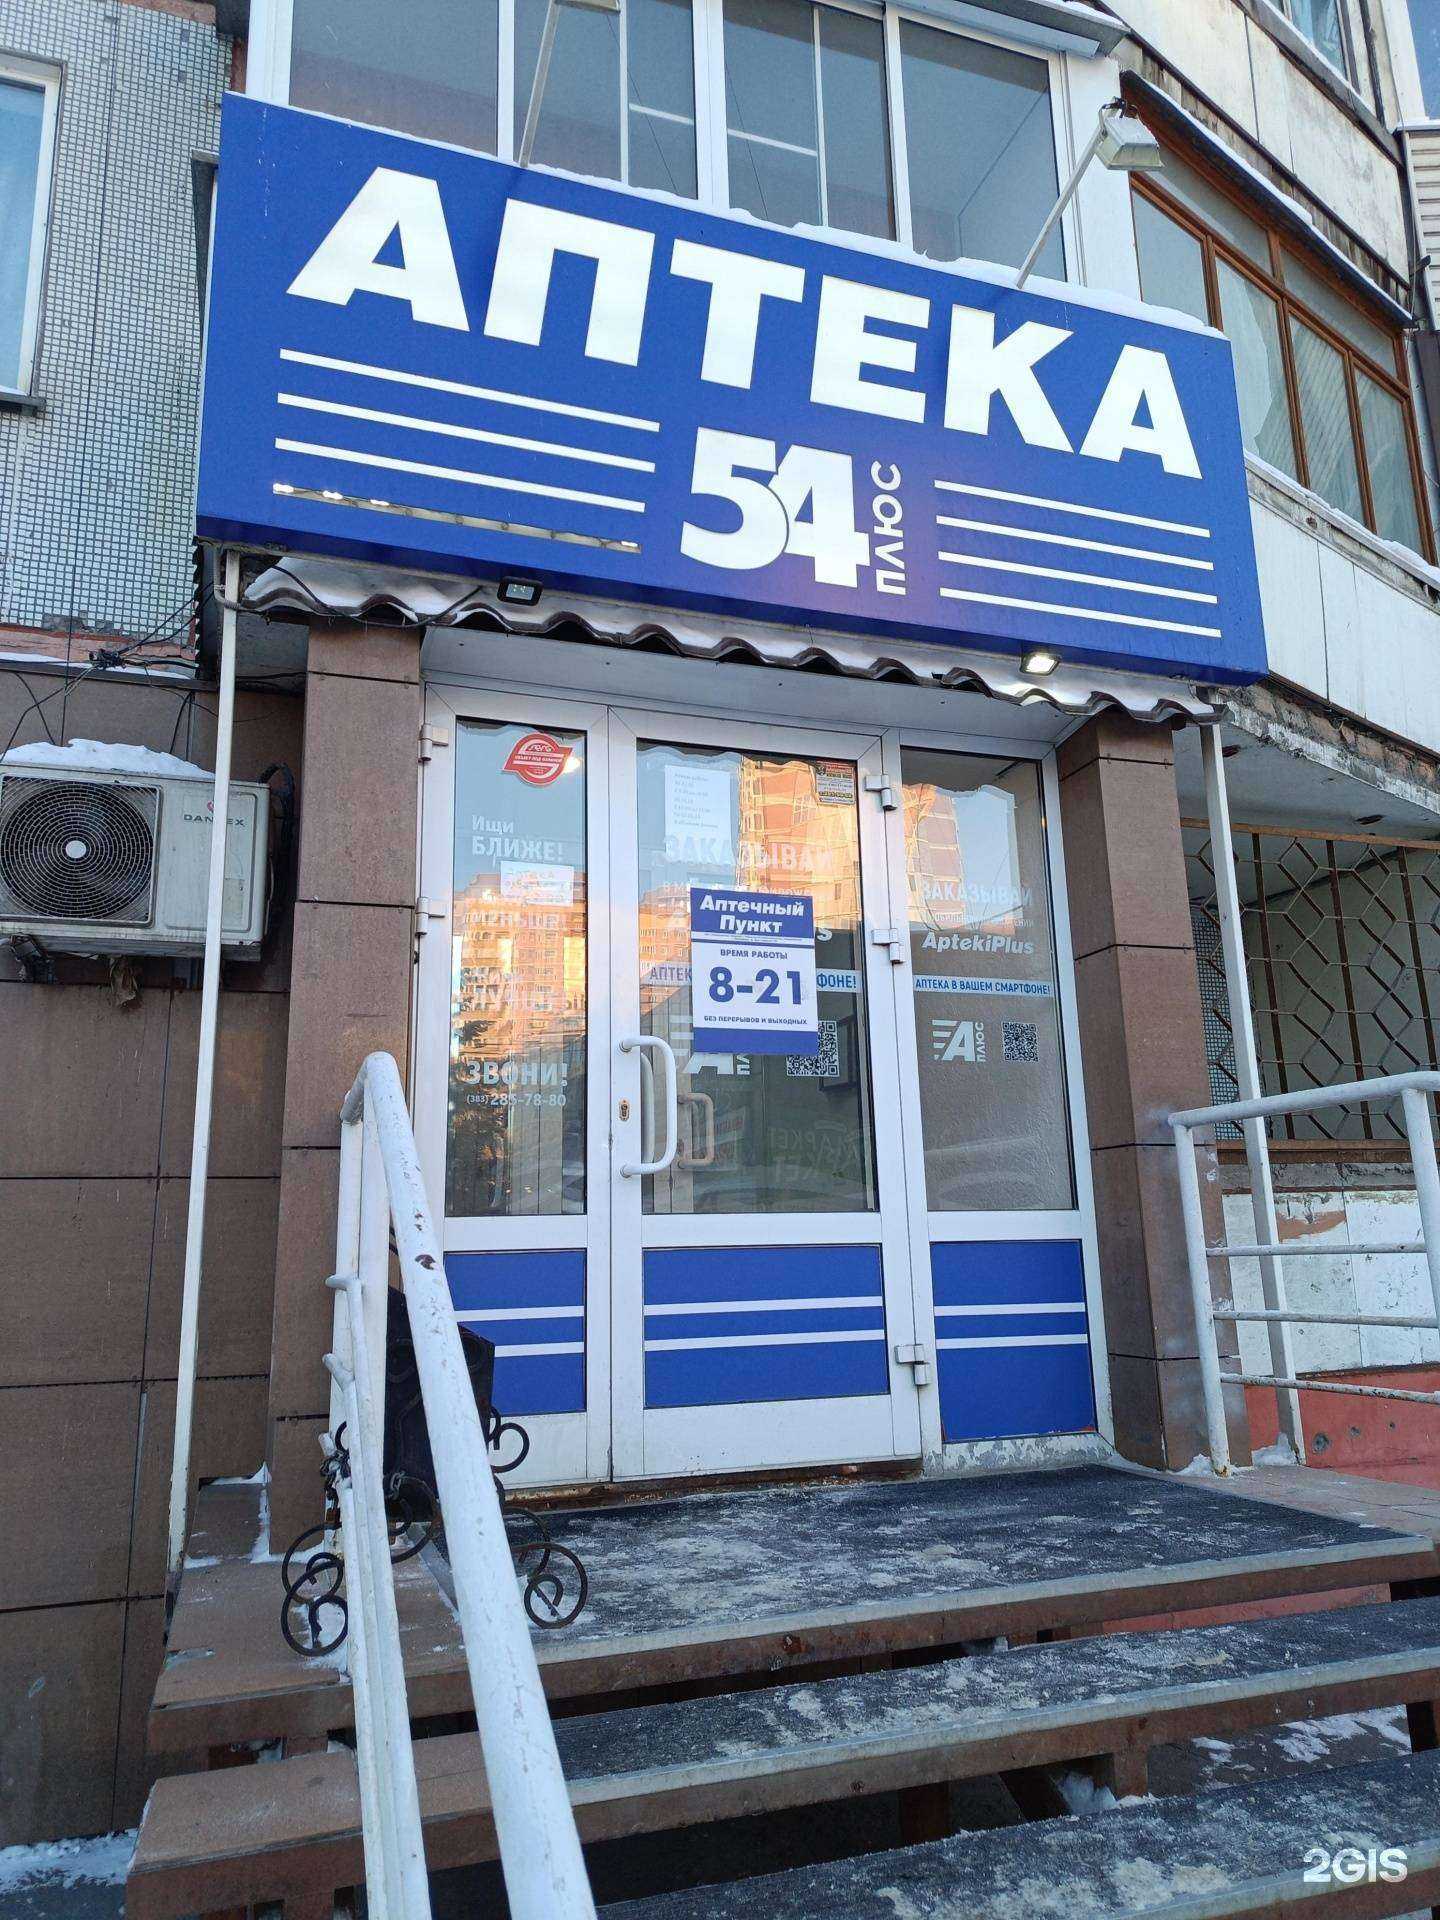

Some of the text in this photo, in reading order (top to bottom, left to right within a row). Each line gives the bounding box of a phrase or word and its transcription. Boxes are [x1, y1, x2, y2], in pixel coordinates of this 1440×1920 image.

[286, 166, 1203, 480] АПТЕКА
[680, 426, 871, 588] 54
[870, 460, 907, 596] ПЛЮС
[183, 814, 246, 829] DANEX
[471, 814, 514, 835] Ищи
[471, 835, 563, 862] БЛИЖЕ!
[700, 894, 805, 917] Аптечный
[719, 914, 783, 934] Пункт
[720, 948, 788, 960] ВРЕМЯ РАБОТЫ
[921, 930, 1036, 955] AptekiPlus
[708, 966, 802, 1006] 8-21
[816, 972, 857, 989] ФОНЕ!
[915, 978, 1050, 995] АПТЕКА В ВАШЕМ СМАРТФОНЕ!
[718, 1015, 760, 1023] ПЕРЕРЫВОВ
[767, 1017, 808, 1025] ВЫХОДНЫХ
[974, 1021, 987, 1063] ПЛЮС
[465, 1060, 568, 1087] ЗВОНИ!
